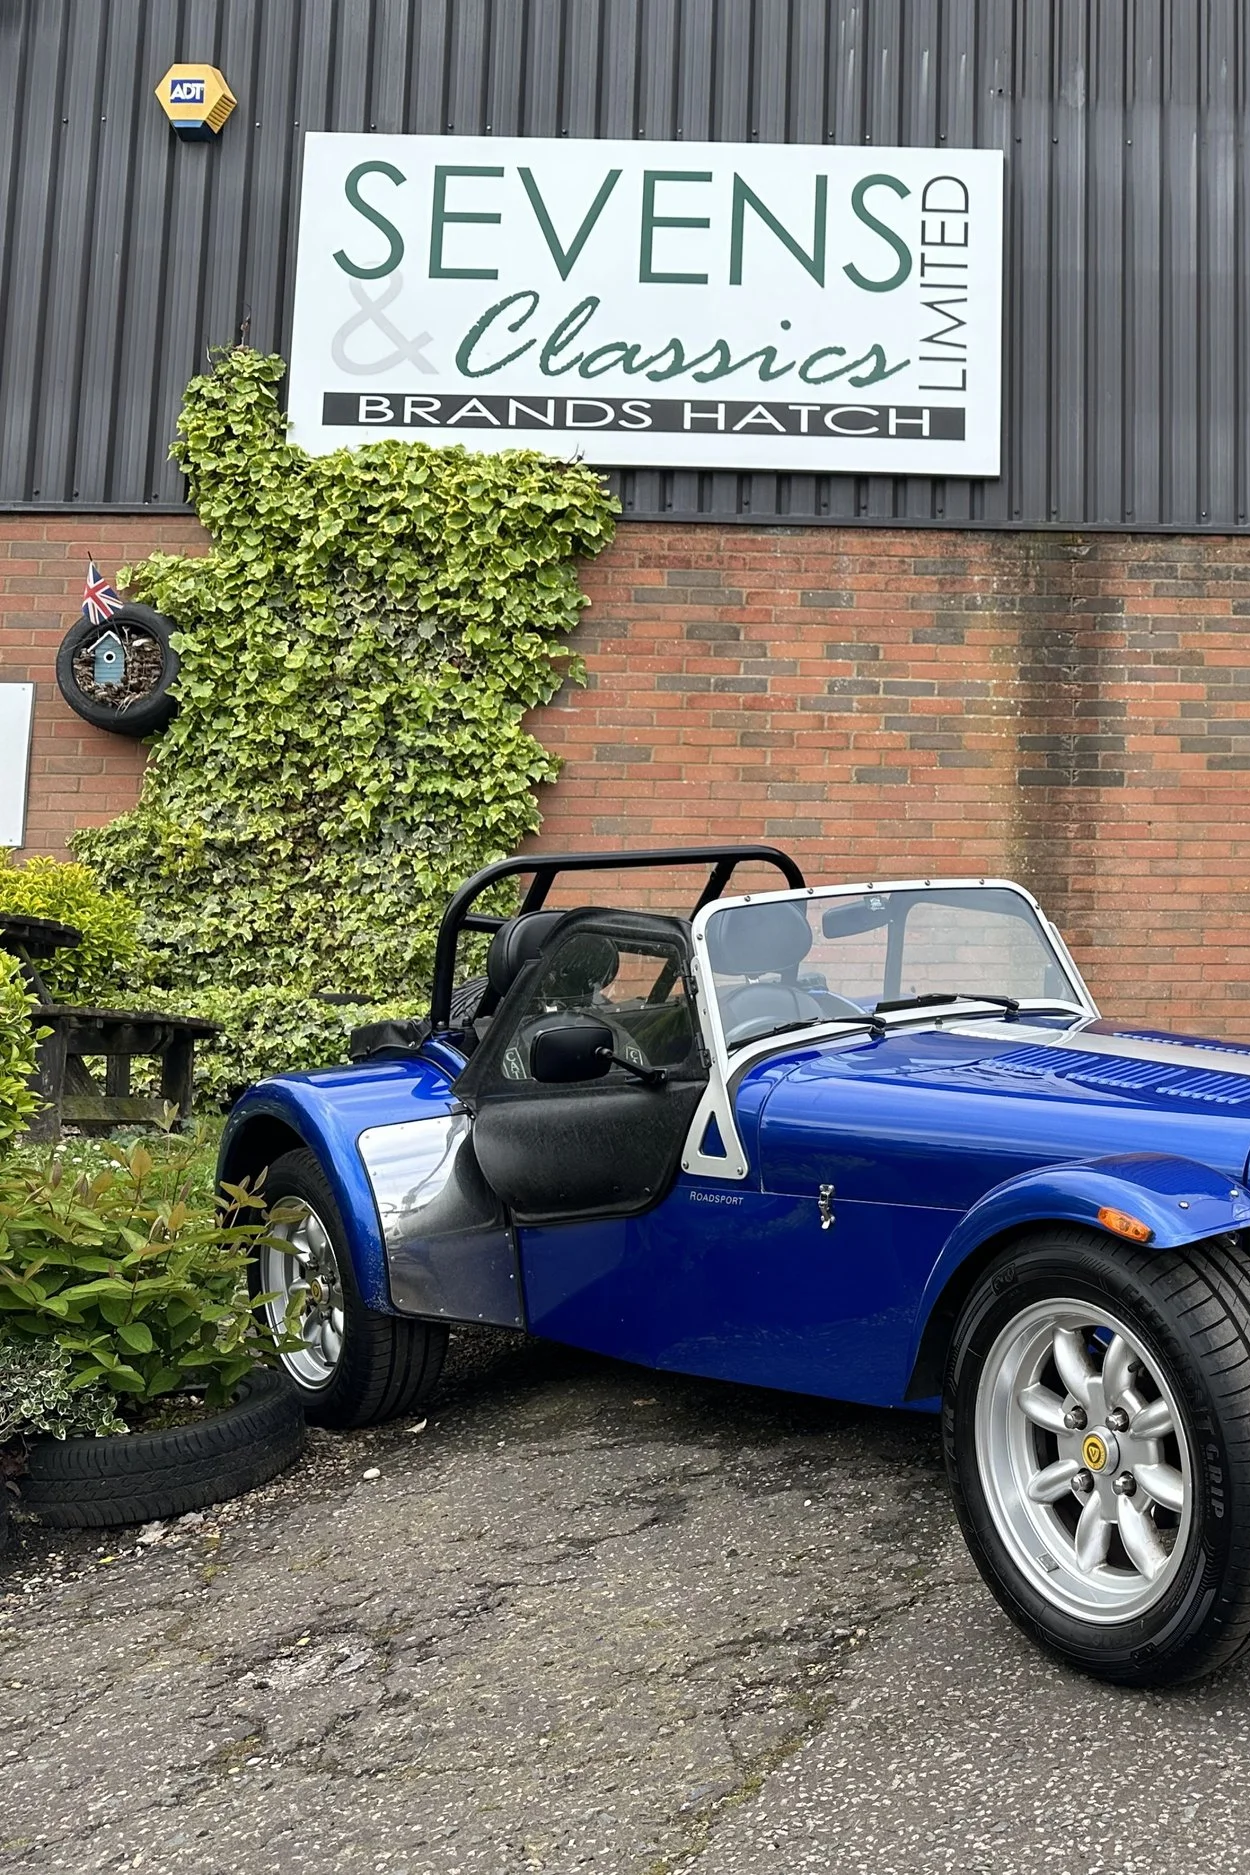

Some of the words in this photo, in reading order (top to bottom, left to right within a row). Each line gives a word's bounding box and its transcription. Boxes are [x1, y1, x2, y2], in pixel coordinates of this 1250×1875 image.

[170, 82, 205, 100] ADT
[332, 159, 913, 293] SEVENS
[331, 260, 441, 377] &
[454, 289, 911, 389] Classics
[918, 174, 970, 392] LIMITED
[357, 395, 653, 430] BRANDS
[683, 402, 931, 437] HATCH
[690, 1190, 744, 1206] ROADSPORT
